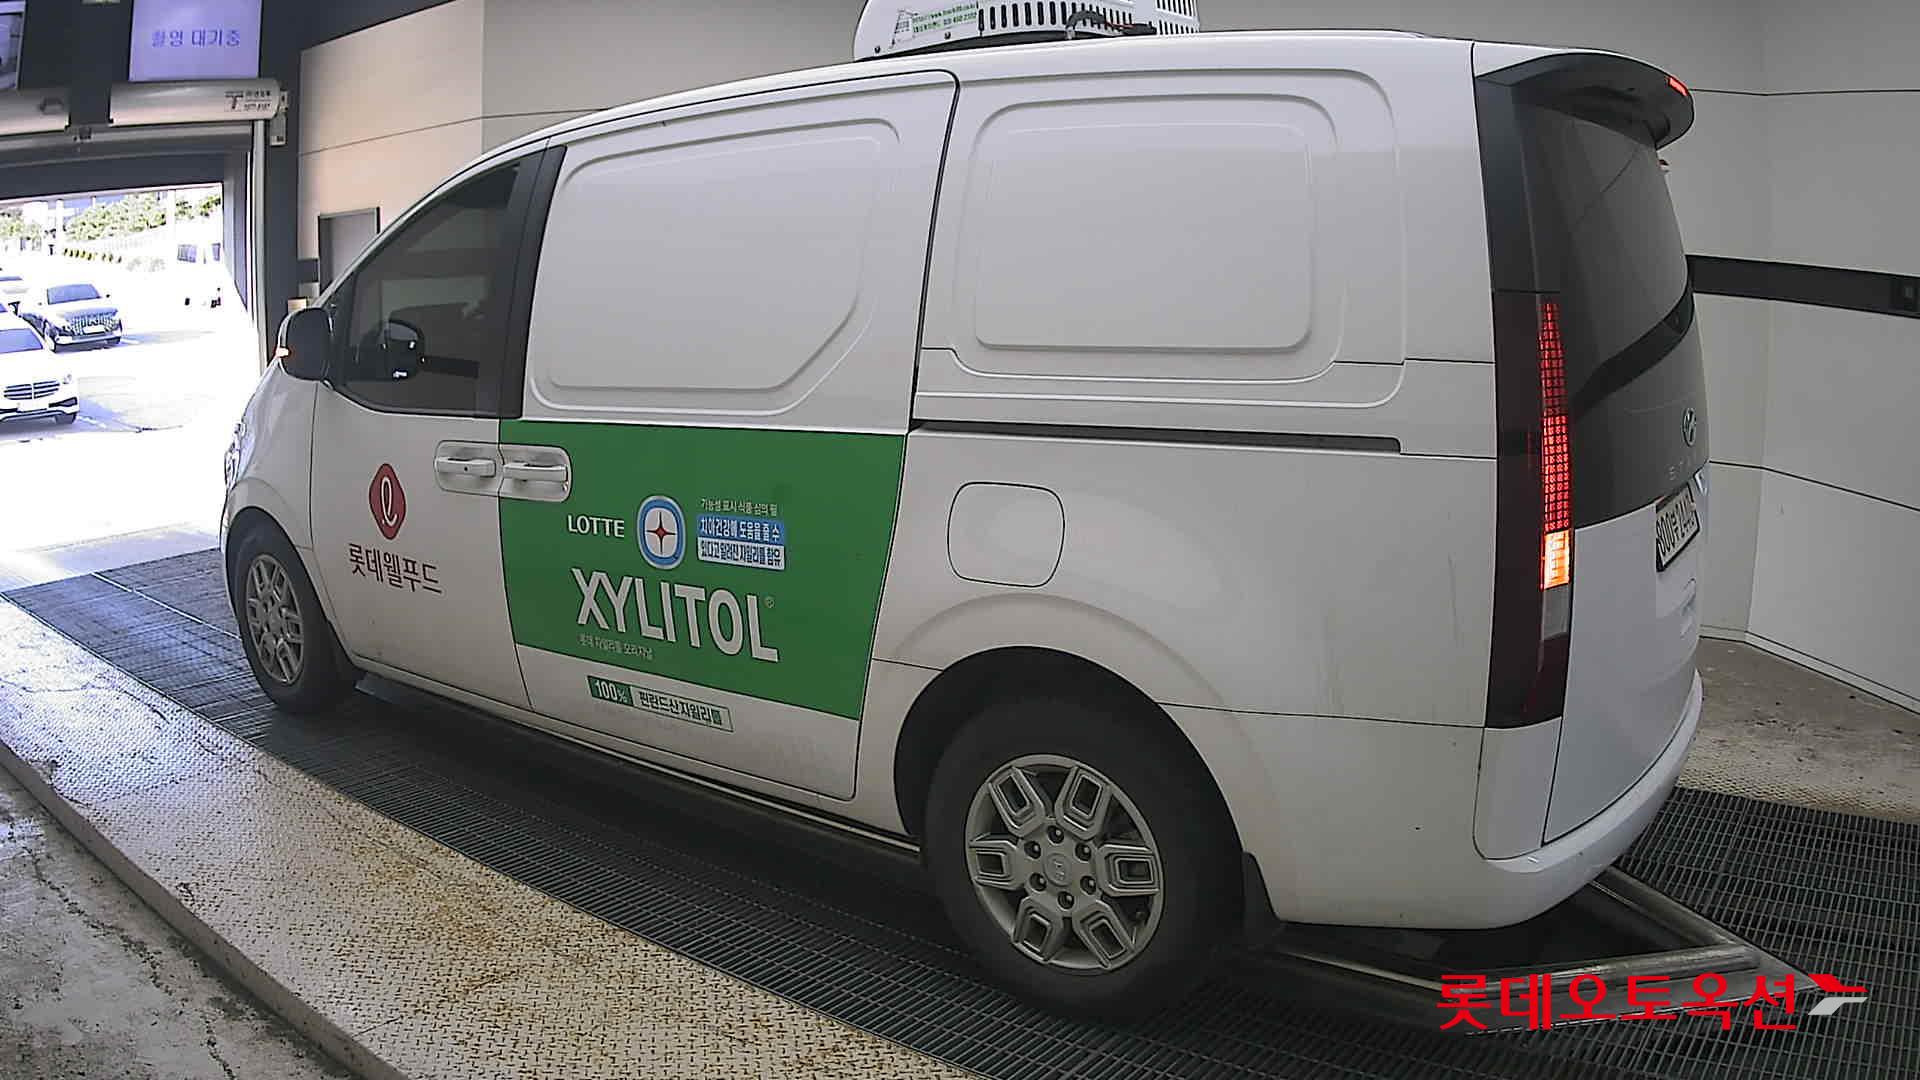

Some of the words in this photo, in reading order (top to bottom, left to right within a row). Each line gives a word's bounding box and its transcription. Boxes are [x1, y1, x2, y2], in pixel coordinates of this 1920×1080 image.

[567, 514, 625, 538] LOTTE
[348, 543, 442, 594] 롯데웰푸드
[570, 567, 779, 663] XYLITOL
[594, 679, 628, 703] 100%
